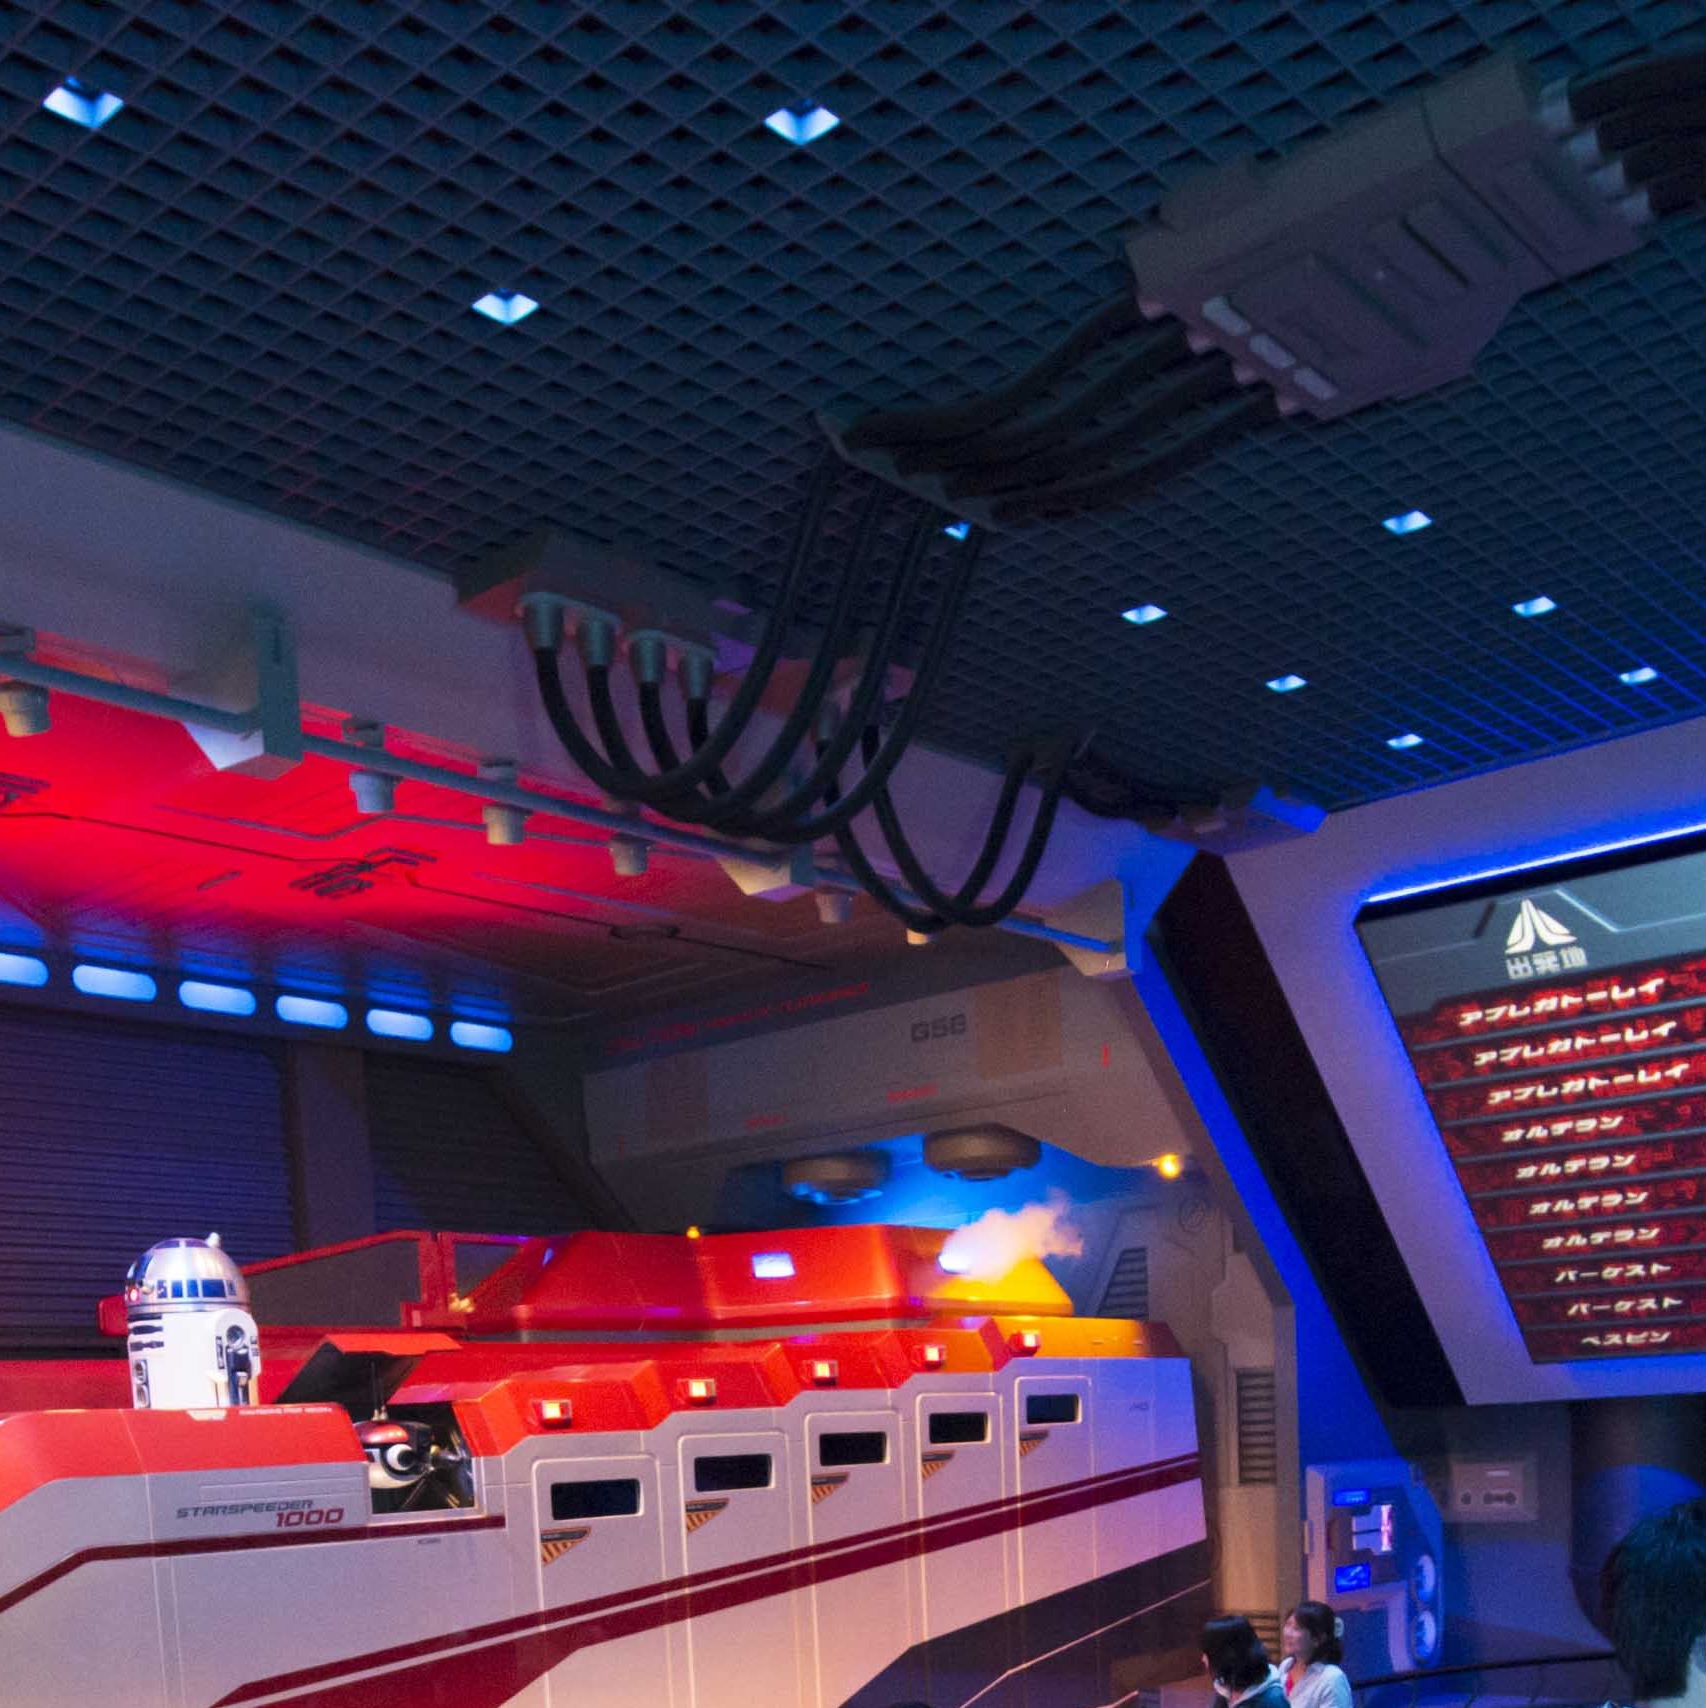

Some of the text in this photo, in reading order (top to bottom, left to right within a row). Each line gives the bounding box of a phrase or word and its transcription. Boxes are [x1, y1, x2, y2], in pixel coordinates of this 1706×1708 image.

[1504, 946, 1590, 980] 出発地
[175, 1499, 314, 1519] STARSPEEDER
[275, 1508, 344, 1528] 1000
